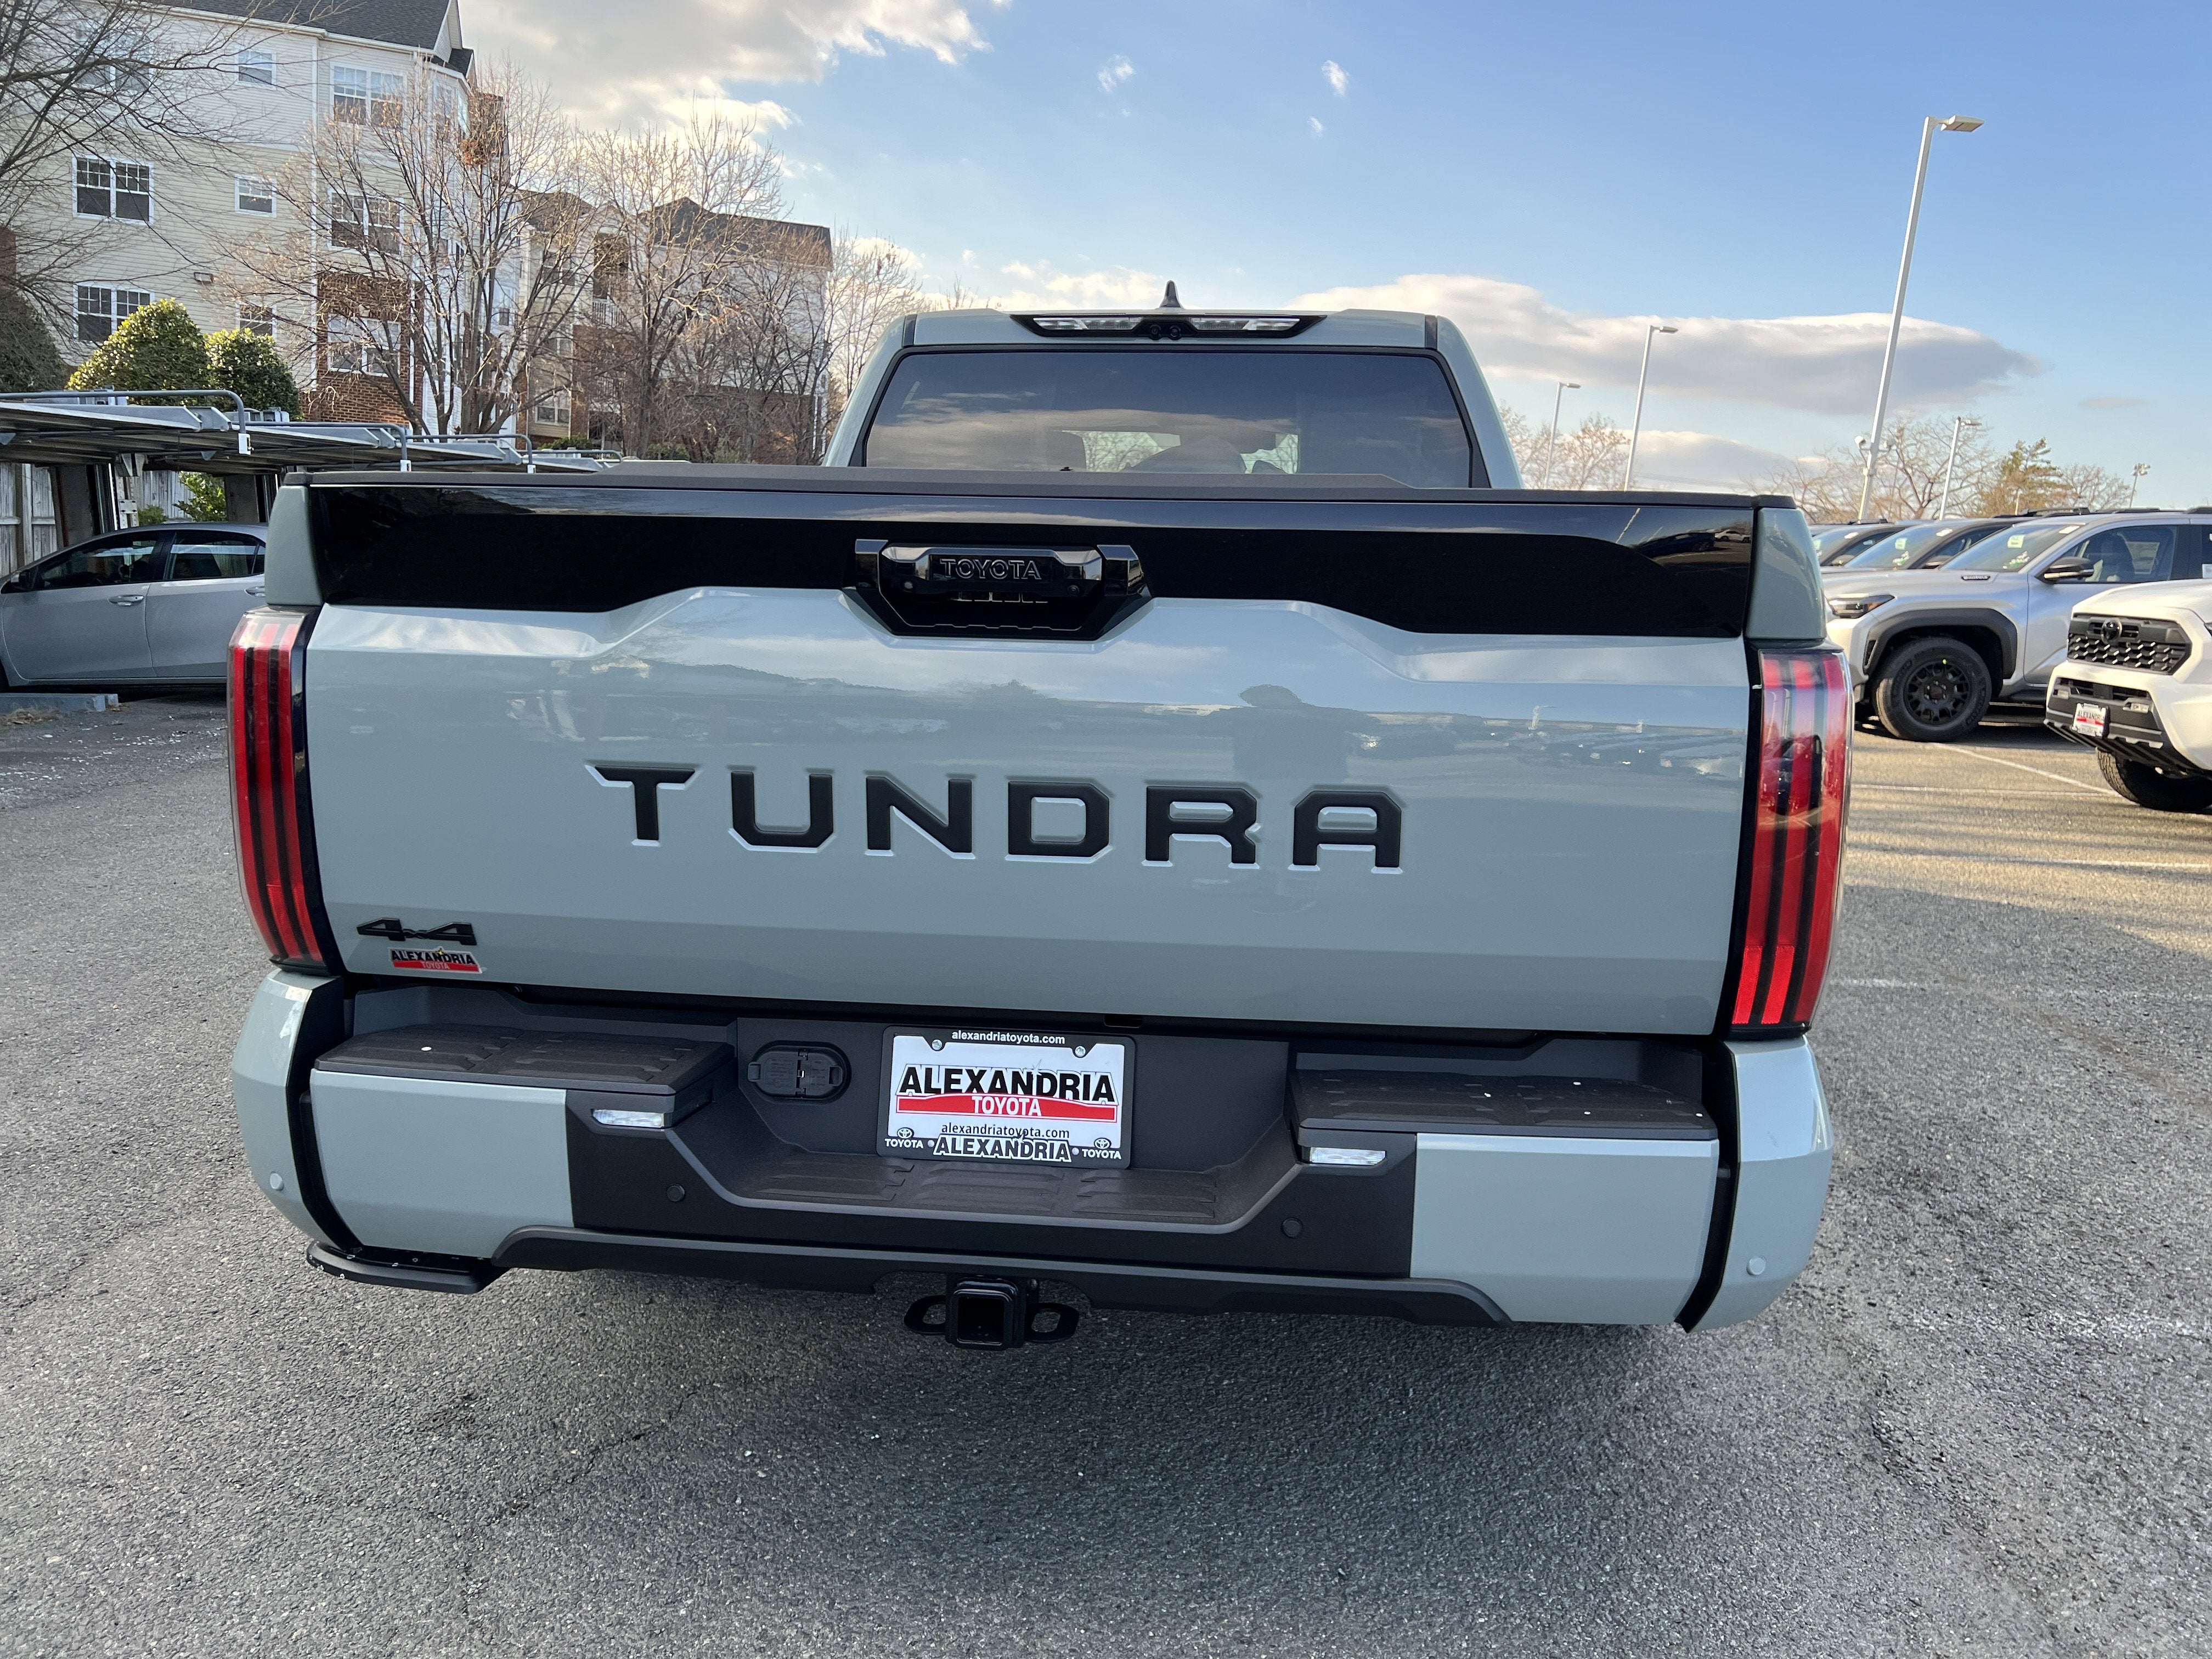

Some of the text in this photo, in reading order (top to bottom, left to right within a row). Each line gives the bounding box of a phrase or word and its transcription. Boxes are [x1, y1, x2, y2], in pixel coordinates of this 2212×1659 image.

[940, 558, 1042, 580] TOYOTA
[588, 765, 1403, 872] TUNDRA
[391, 950, 477, 966] ALEXANDRIA
[421, 961, 450, 970] TOYOTA
[951, 1030, 1065, 1045] alexandriatoyota.com
[899, 1066, 1116, 1102] ALEXANDRIA
[972, 1096, 1042, 1116] TOYOTA
[941, 1122, 1070, 1139] alexandriatoyota.com
[884, 1138, 924, 1149] TOYOTA
[933, 1135, 1071, 1163] ALEXANDRIA
[1082, 1148, 1121, 1160] TOYOTA
